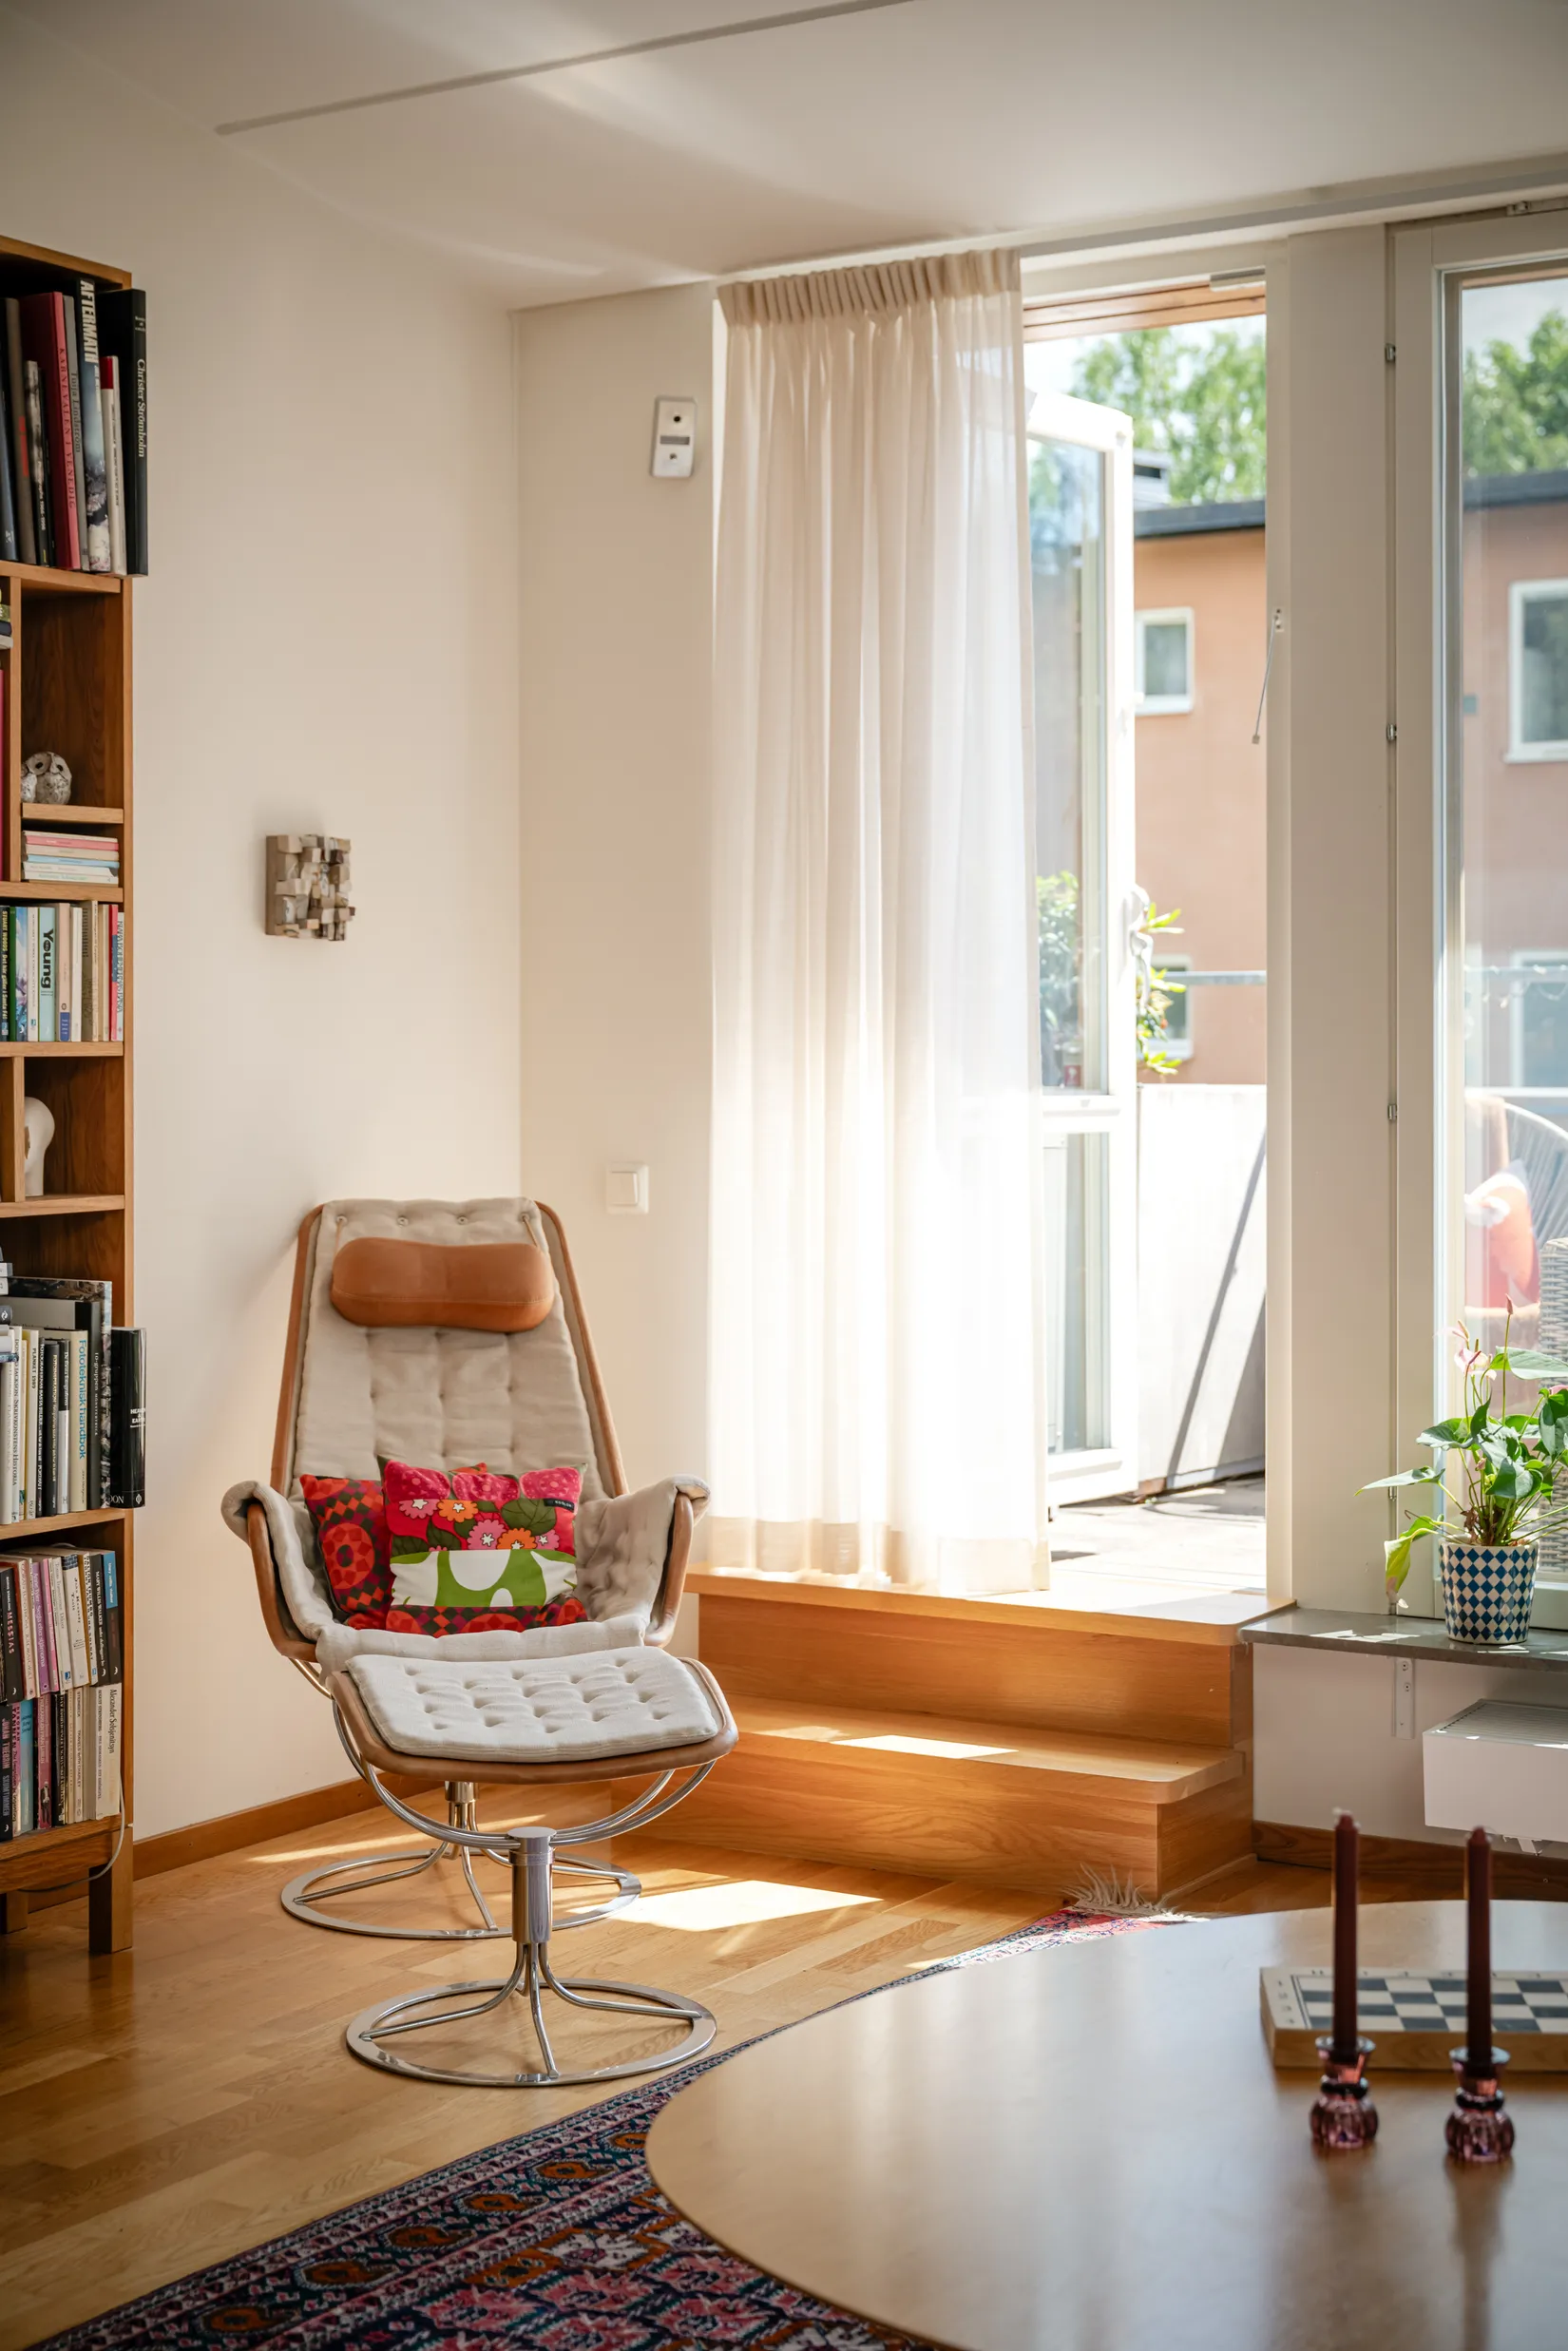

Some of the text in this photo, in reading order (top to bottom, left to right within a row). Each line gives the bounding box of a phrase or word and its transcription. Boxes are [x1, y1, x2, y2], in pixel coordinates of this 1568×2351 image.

[80, 279, 100, 363] AFTERMATH
[59, 347, 71, 434] KARNEVALEN
[67, 453, 76, 509] VENEDIG
[73, 399, 83, 453] Lindström
[136, 358, 147, 458] Christer Strömholm
[41, 927, 55, 988] Young
[78, 1339, 87, 1460] Fototeknisk handbok
[7, 1612, 15, 1654] MESSIAS
[107, 1718, 118, 1754] Solsjenitsyn
[108, 1689, 118, 1718] Alexander
[2, 1718, 10, 1817] JOHAN THEORIN SKUMTIMMEN
